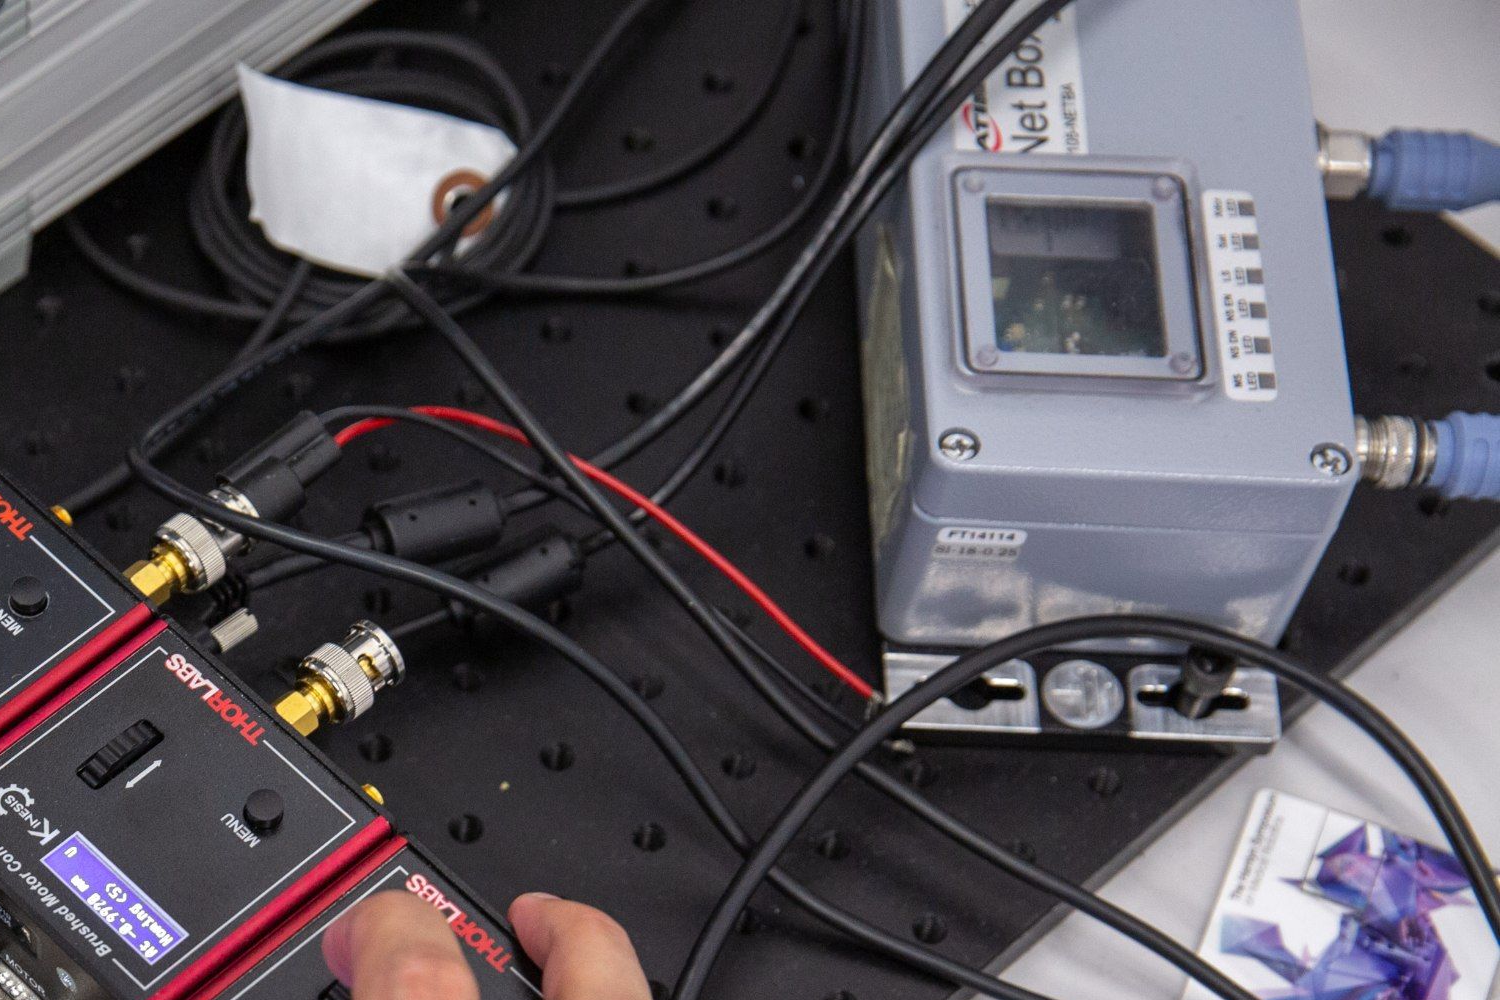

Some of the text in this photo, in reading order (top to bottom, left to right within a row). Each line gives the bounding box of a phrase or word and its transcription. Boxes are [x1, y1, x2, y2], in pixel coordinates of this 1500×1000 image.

[1006, 32, 1050, 153] Net Bo
[1238, 299, 1248, 318] LED
[1242, 335, 1253, 354] LED
[1247, 371, 1257, 391] LED
[948, 529, 1015, 541] FT14114
[164, 653, 266, 746] THORLABS
[220, 813, 261, 848] MENU
[19, 871, 62, 908] Motor
[53, 905, 112, 958] Brushed
[128, 903, 174, 948] Homing
[405, 873, 513, 974] THORLABS
[139, 939, 159, 958] At
[5, 954, 47, 997] MOTOR
